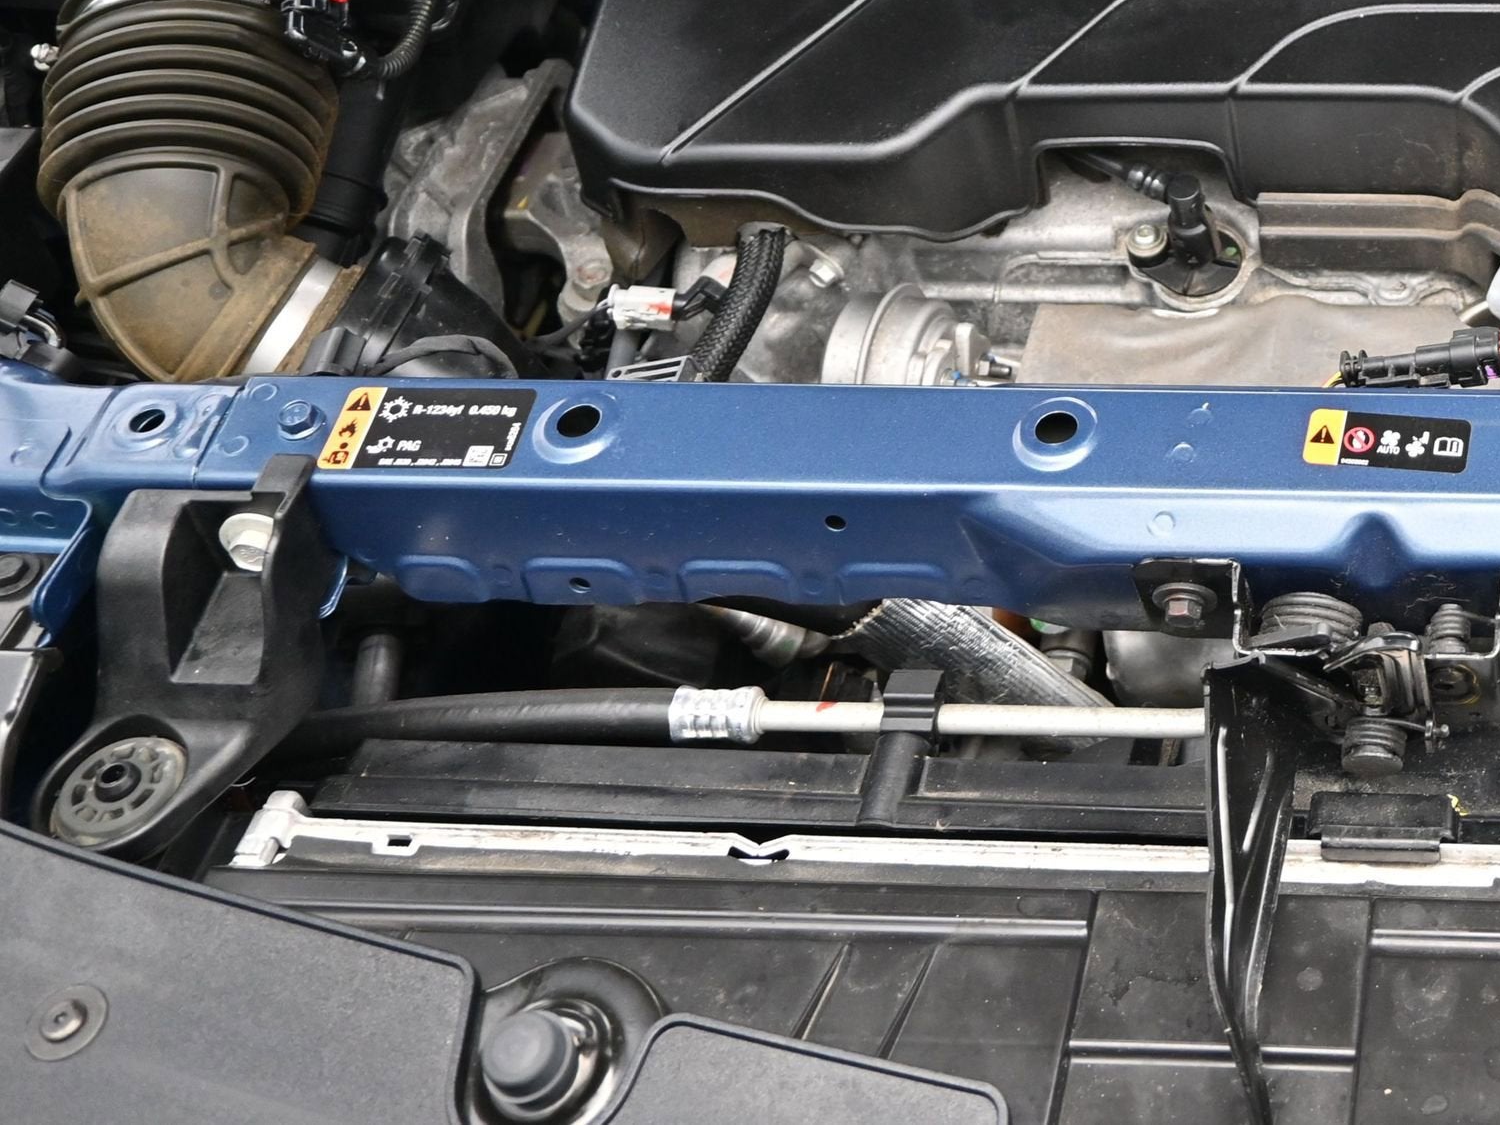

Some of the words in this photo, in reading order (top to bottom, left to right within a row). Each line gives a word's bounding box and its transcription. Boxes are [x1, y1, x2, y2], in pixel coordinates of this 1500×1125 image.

[501, 405, 517, 417] kg
[396, 440, 422, 451] PAG
[1376, 445, 1400, 455] AUTO
